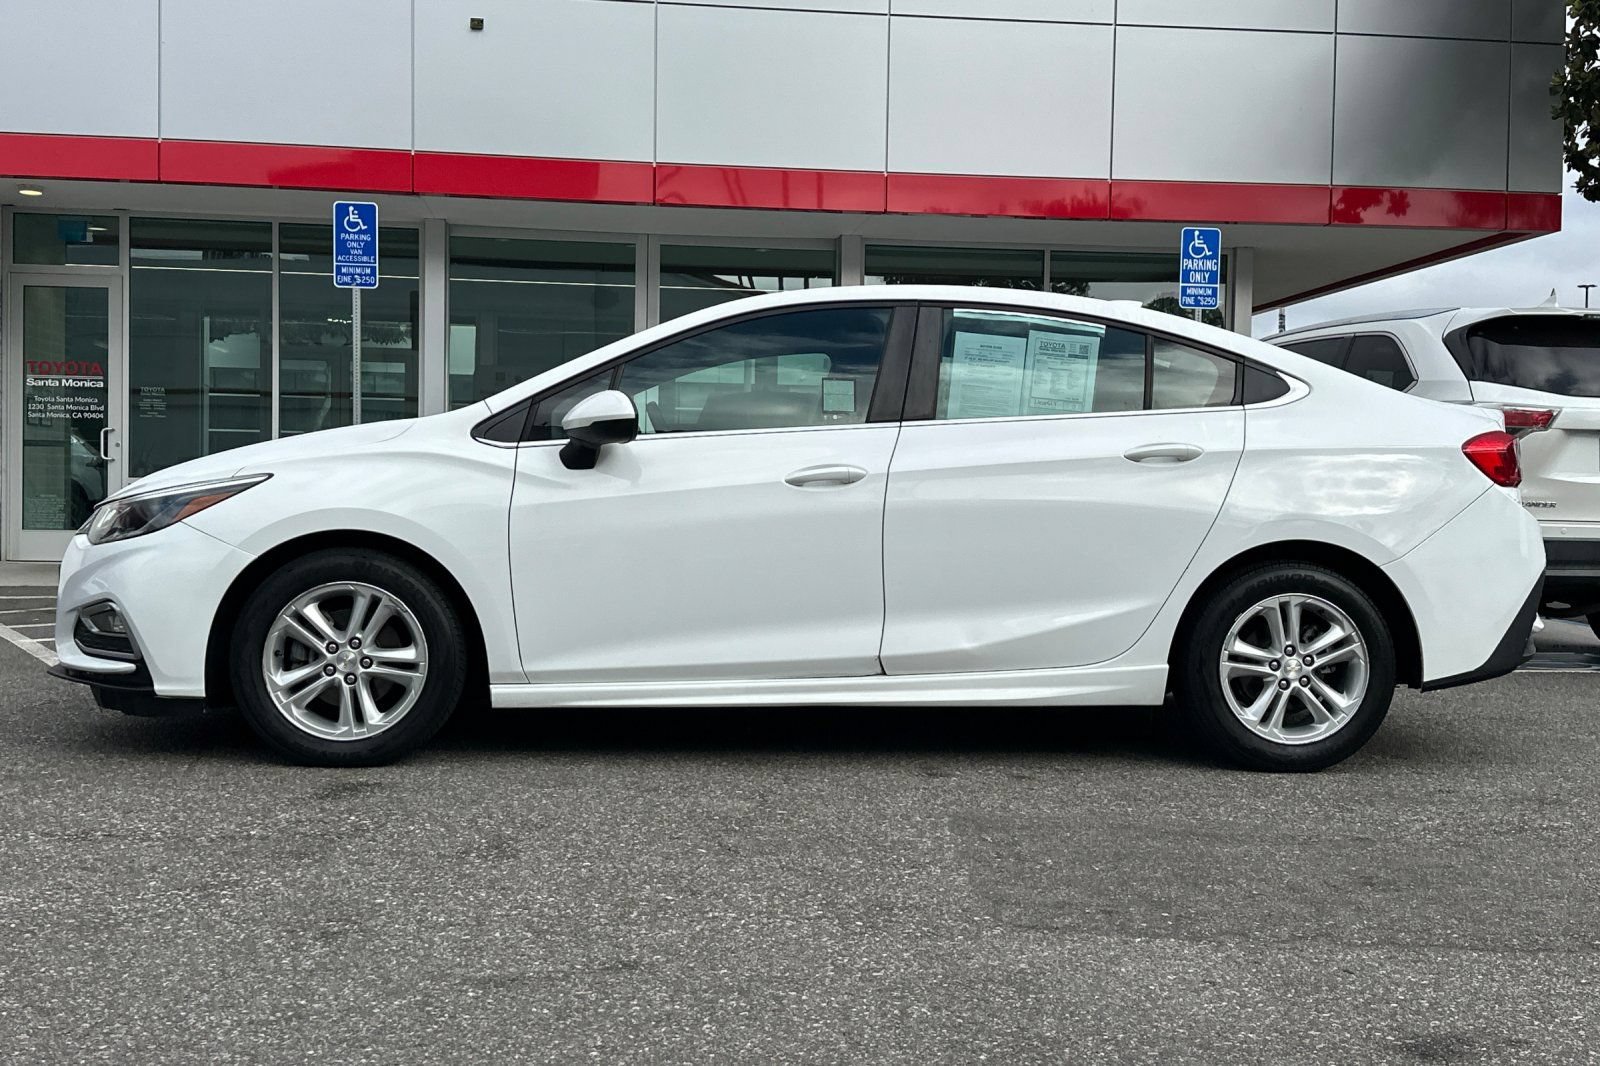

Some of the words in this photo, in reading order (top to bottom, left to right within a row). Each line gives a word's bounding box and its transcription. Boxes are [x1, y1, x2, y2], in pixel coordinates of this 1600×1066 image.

[340, 233, 371, 241] PARKING
[1183, 259, 1217, 271] PARKING
[341, 266, 371, 274] MINIMUM
[1190, 271, 1210, 283] ONLY
[1186, 287, 1212, 295] MINIMUM
[1200, 297, 1216, 306] $250
[1040, 341, 1066, 349] TOYOTA
[27, 360, 104, 376] TOYOTA
[26, 378, 59, 387] Santa
[61, 379, 104, 388] Monica
[34, 395, 54, 403] Toyota
